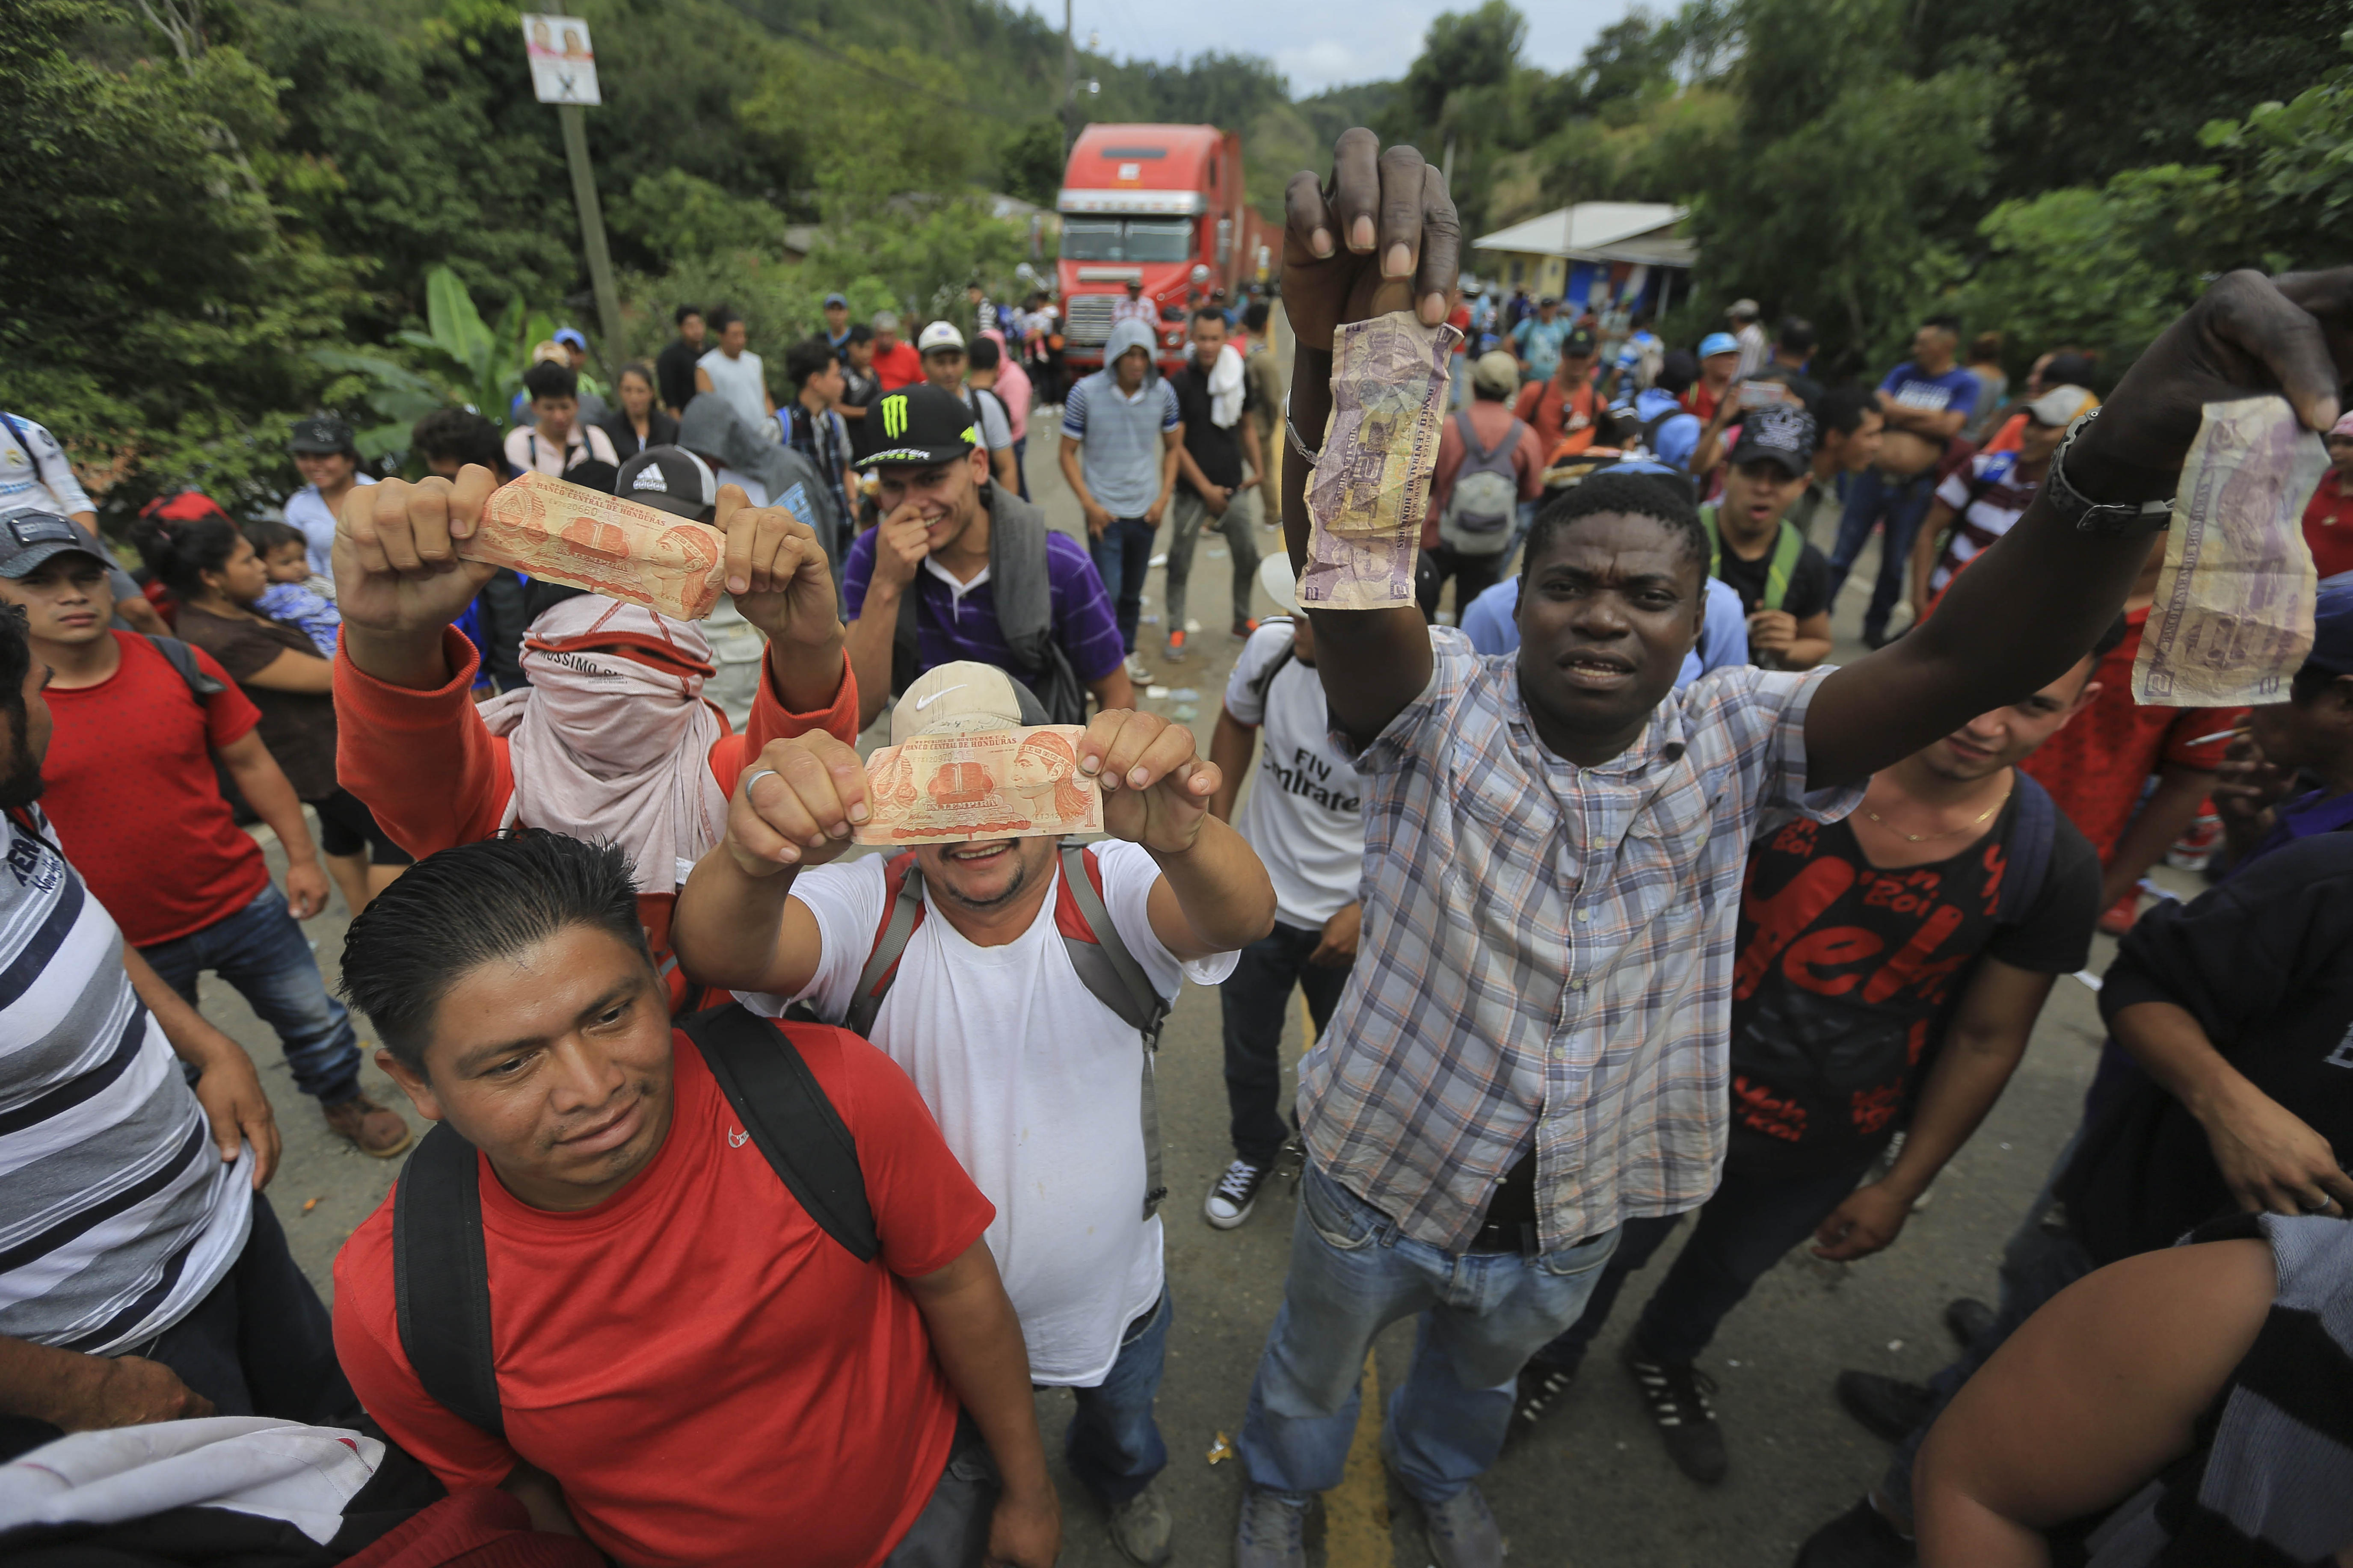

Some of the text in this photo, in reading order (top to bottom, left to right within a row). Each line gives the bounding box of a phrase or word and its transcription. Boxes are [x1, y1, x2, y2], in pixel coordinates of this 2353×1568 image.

[1418, 388, 1435, 426] BANCO
[1410, 430, 1425, 478] CENTRAL
[536, 482, 666, 526] BANCO CENTRAL DE HONDURAS
[1406, 481, 1414, 495] DE
[1396, 497, 1411, 549] HONDURAS
[971, 737, 1017, 748] HONDURAS
[1294, 746, 1332, 782] Fly
[923, 798, 998, 811] UN LEMPIRA
[1084, 803, 1097, 827] 1
